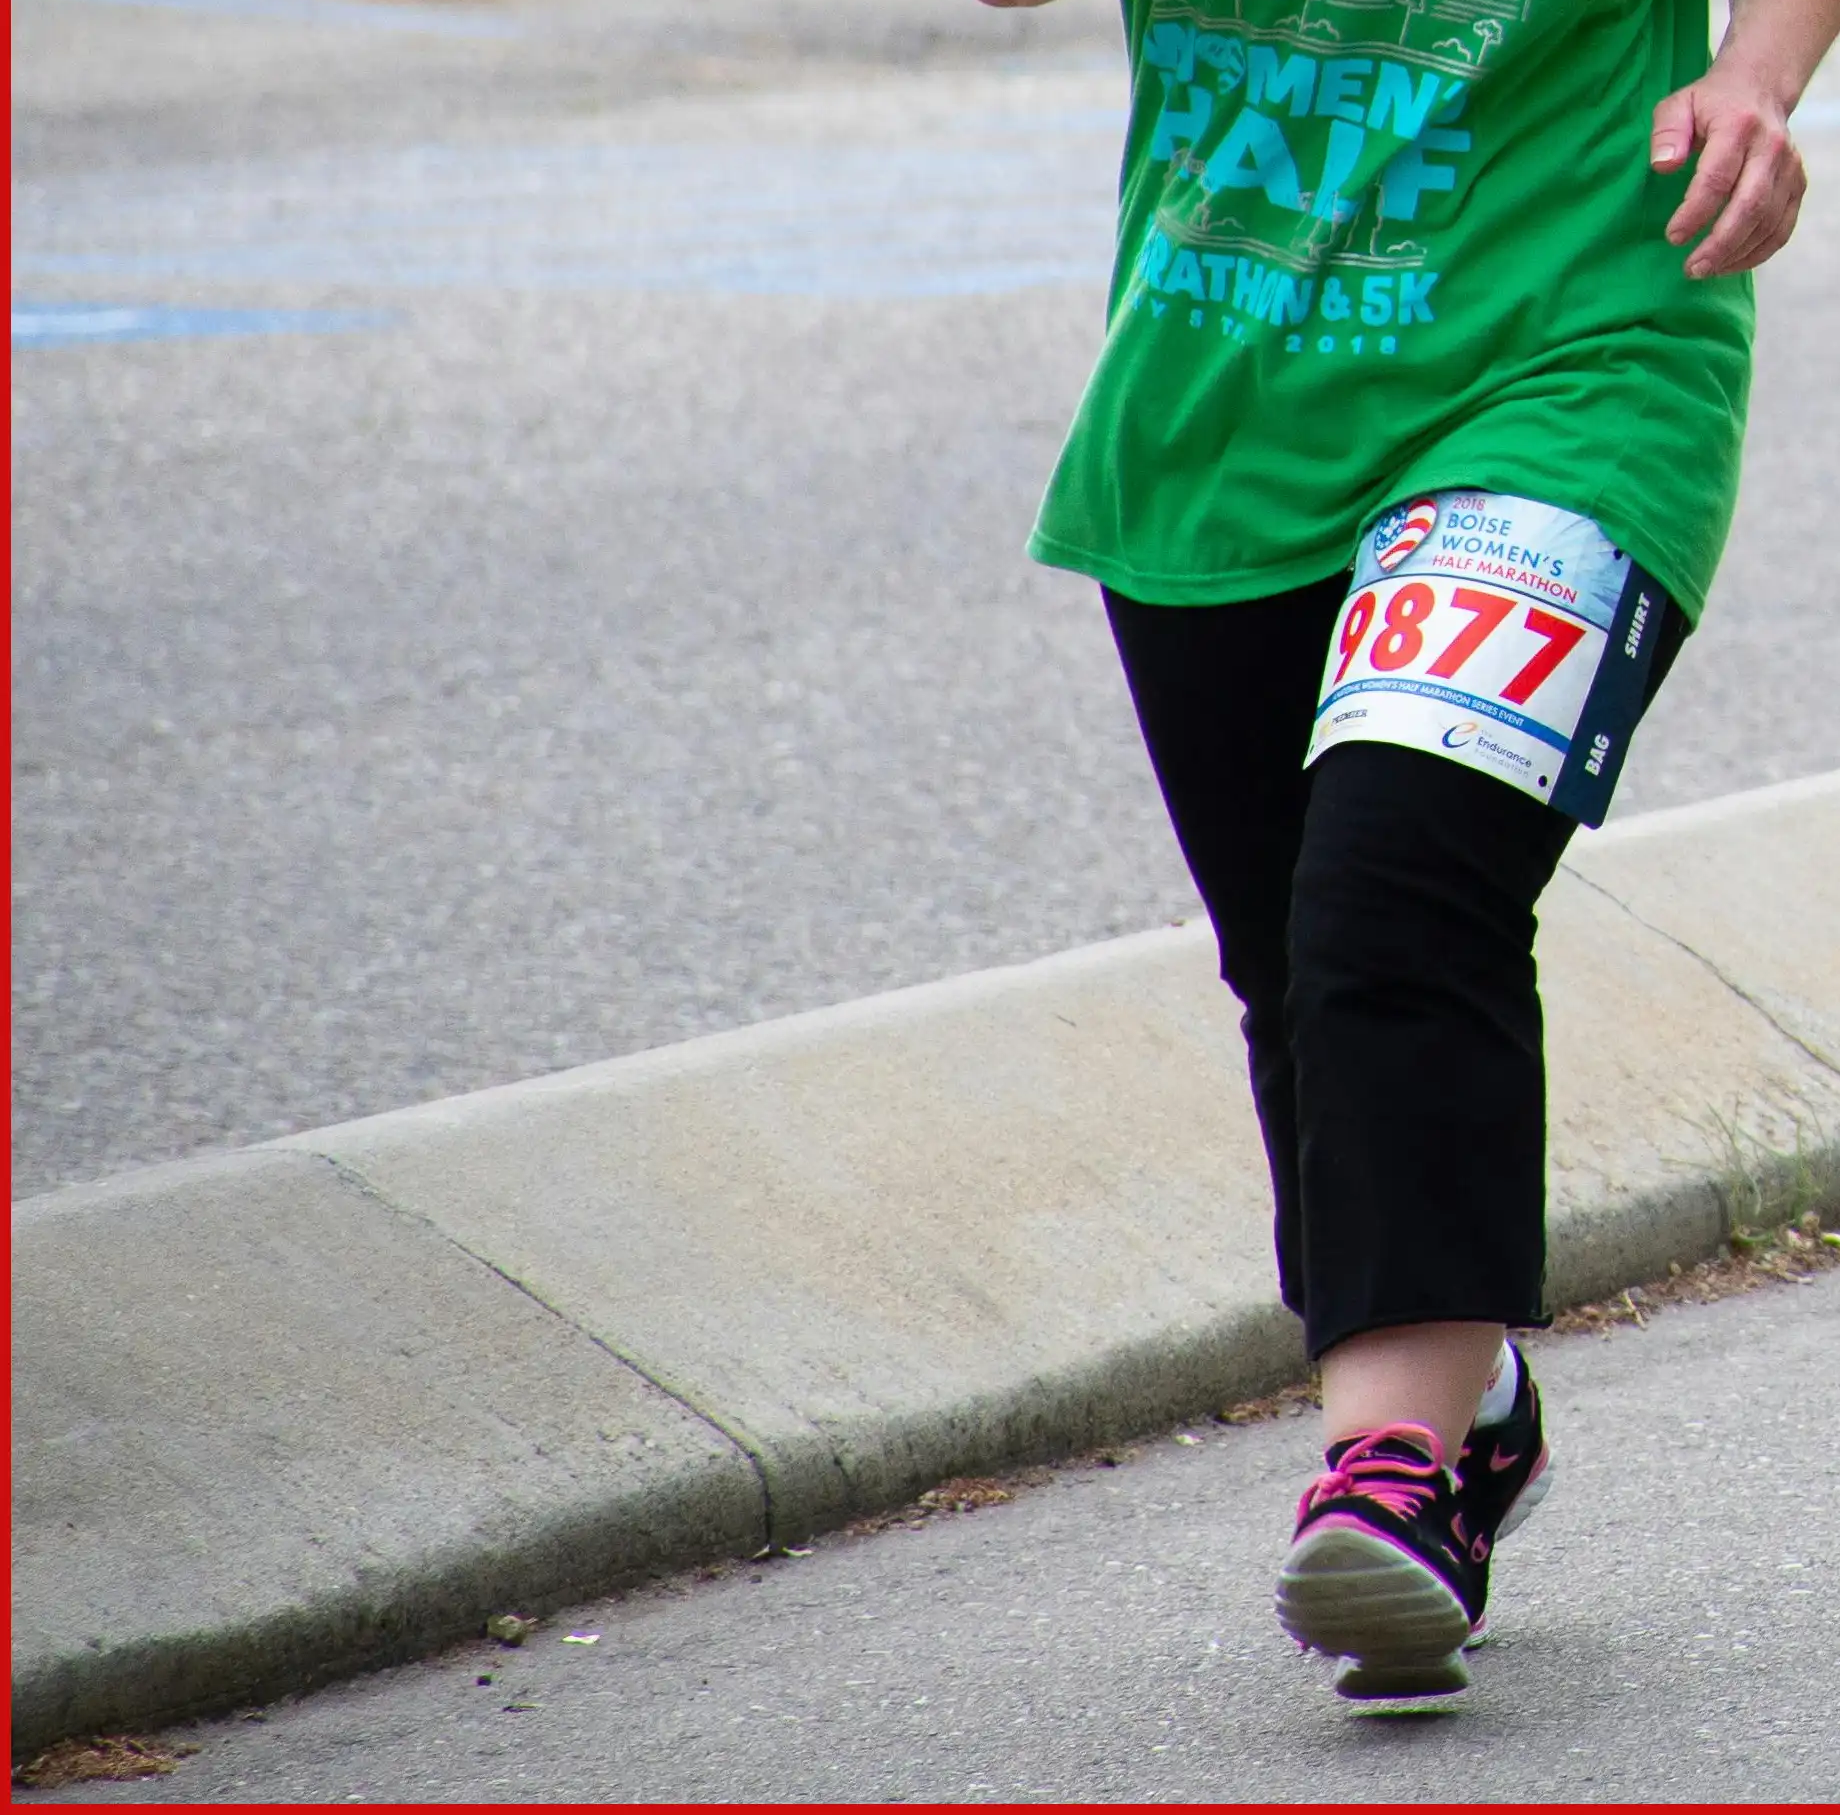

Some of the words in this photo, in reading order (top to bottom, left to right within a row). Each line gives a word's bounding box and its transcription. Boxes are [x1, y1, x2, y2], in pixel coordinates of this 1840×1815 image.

[1151, 72, 1471, 222] HALF
[1320, 277, 1351, 321] &
[1360, 272, 1439, 327] 5K
[1285, 334, 1397, 355] 2018
[1446, 514, 1512, 536] BOISE
[1453, 497, 1486, 511] 2018
[1442, 535, 1564, 577] WOMEN'S
[1433, 555, 1473, 570] HALF
[1476, 560, 1578, 603] MARATHON
[1333, 582, 1587, 706] 9877
[1624, 592, 1650, 659] SHIRT
[1421, 685, 1471, 705] MARATHON
[1472, 698, 1498, 716] SERIES
[1499, 709, 1525, 726] EVENT
[1477, 736, 1532, 768] Endurance
[1585, 733, 1610, 776] BAG
